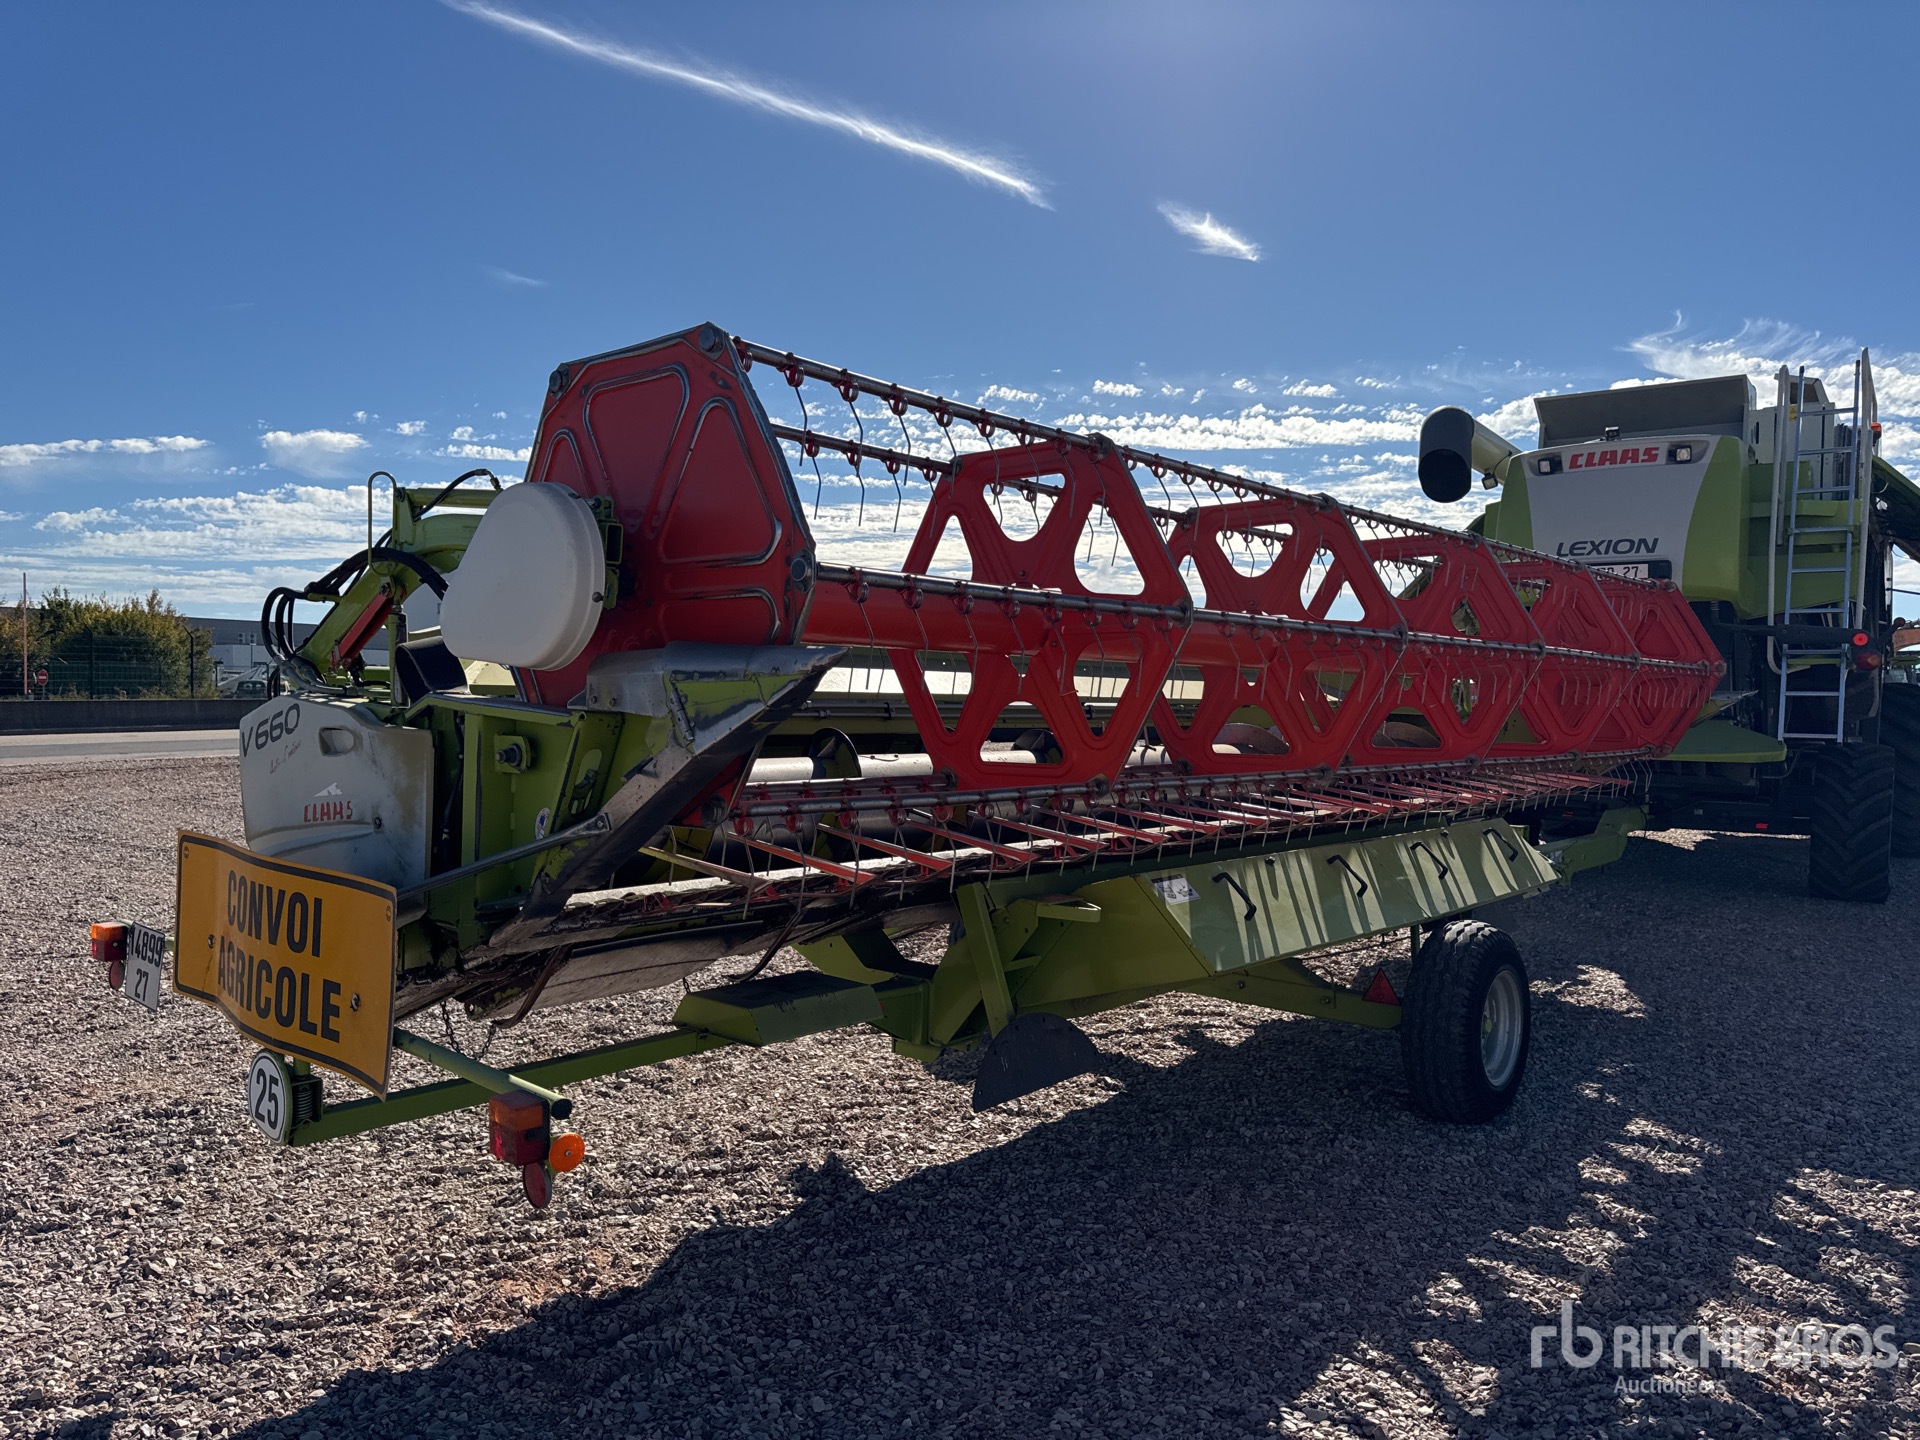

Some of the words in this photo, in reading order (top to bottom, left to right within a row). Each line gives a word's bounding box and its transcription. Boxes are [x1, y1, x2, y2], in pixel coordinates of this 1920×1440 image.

[1569, 447, 1660, 470] CLAAS
[1556, 537, 1659, 557] LEXION
[241, 703, 300, 757] V660
[227, 869, 323, 958] CONVOI
[129, 926, 163, 968] 14899
[134, 968, 149, 1002] 27
[217, 935, 342, 1043] AGRICOLE
[254, 1068, 280, 1130] 25
